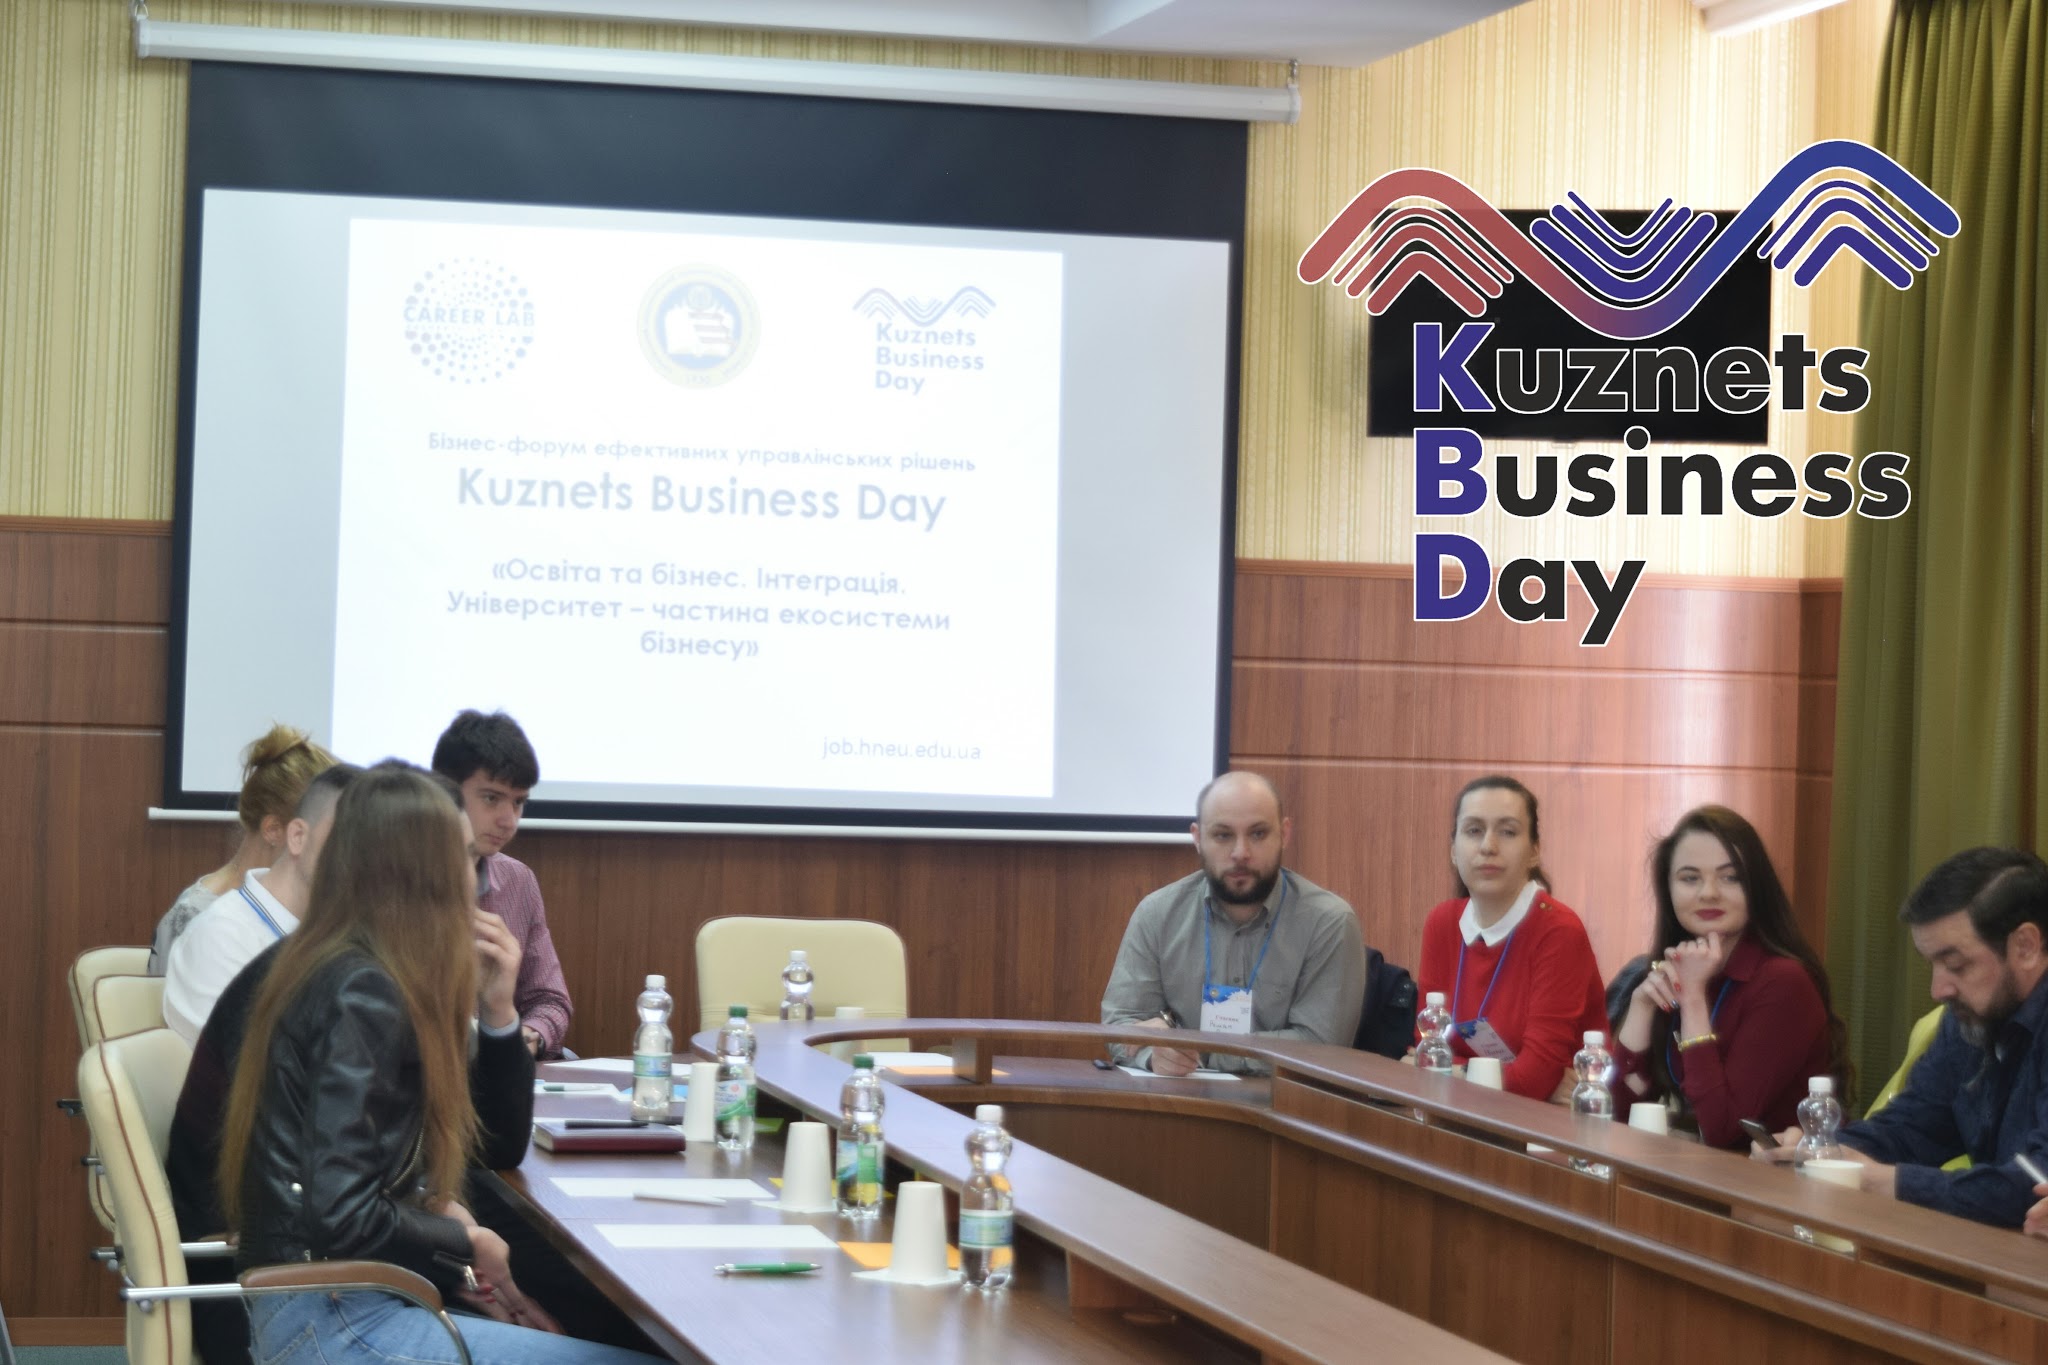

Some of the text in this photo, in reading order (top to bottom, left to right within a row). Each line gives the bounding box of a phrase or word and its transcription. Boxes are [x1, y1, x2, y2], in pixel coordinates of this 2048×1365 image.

[402, 305, 536, 328] CAREER LAB
[876, 321, 977, 347] Kuznets
[875, 345, 985, 370] Business
[874, 369, 925, 396] Day
[428, 431, 977, 473] Бізнес-форум ефективних управлінських рішень
[456, 466, 948, 533] Kuznets Business Day
[491, 556, 907, 597] «Освіта та бізнес. Інтеграція.
[446, 589, 624, 622] Університет
[651, 602, 770, 625] частина
[777, 606, 951, 632] екосистеми
[639, 628, 760, 662] бізнесу»
[821, 735, 983, 761] job.hneu.edu.ua
